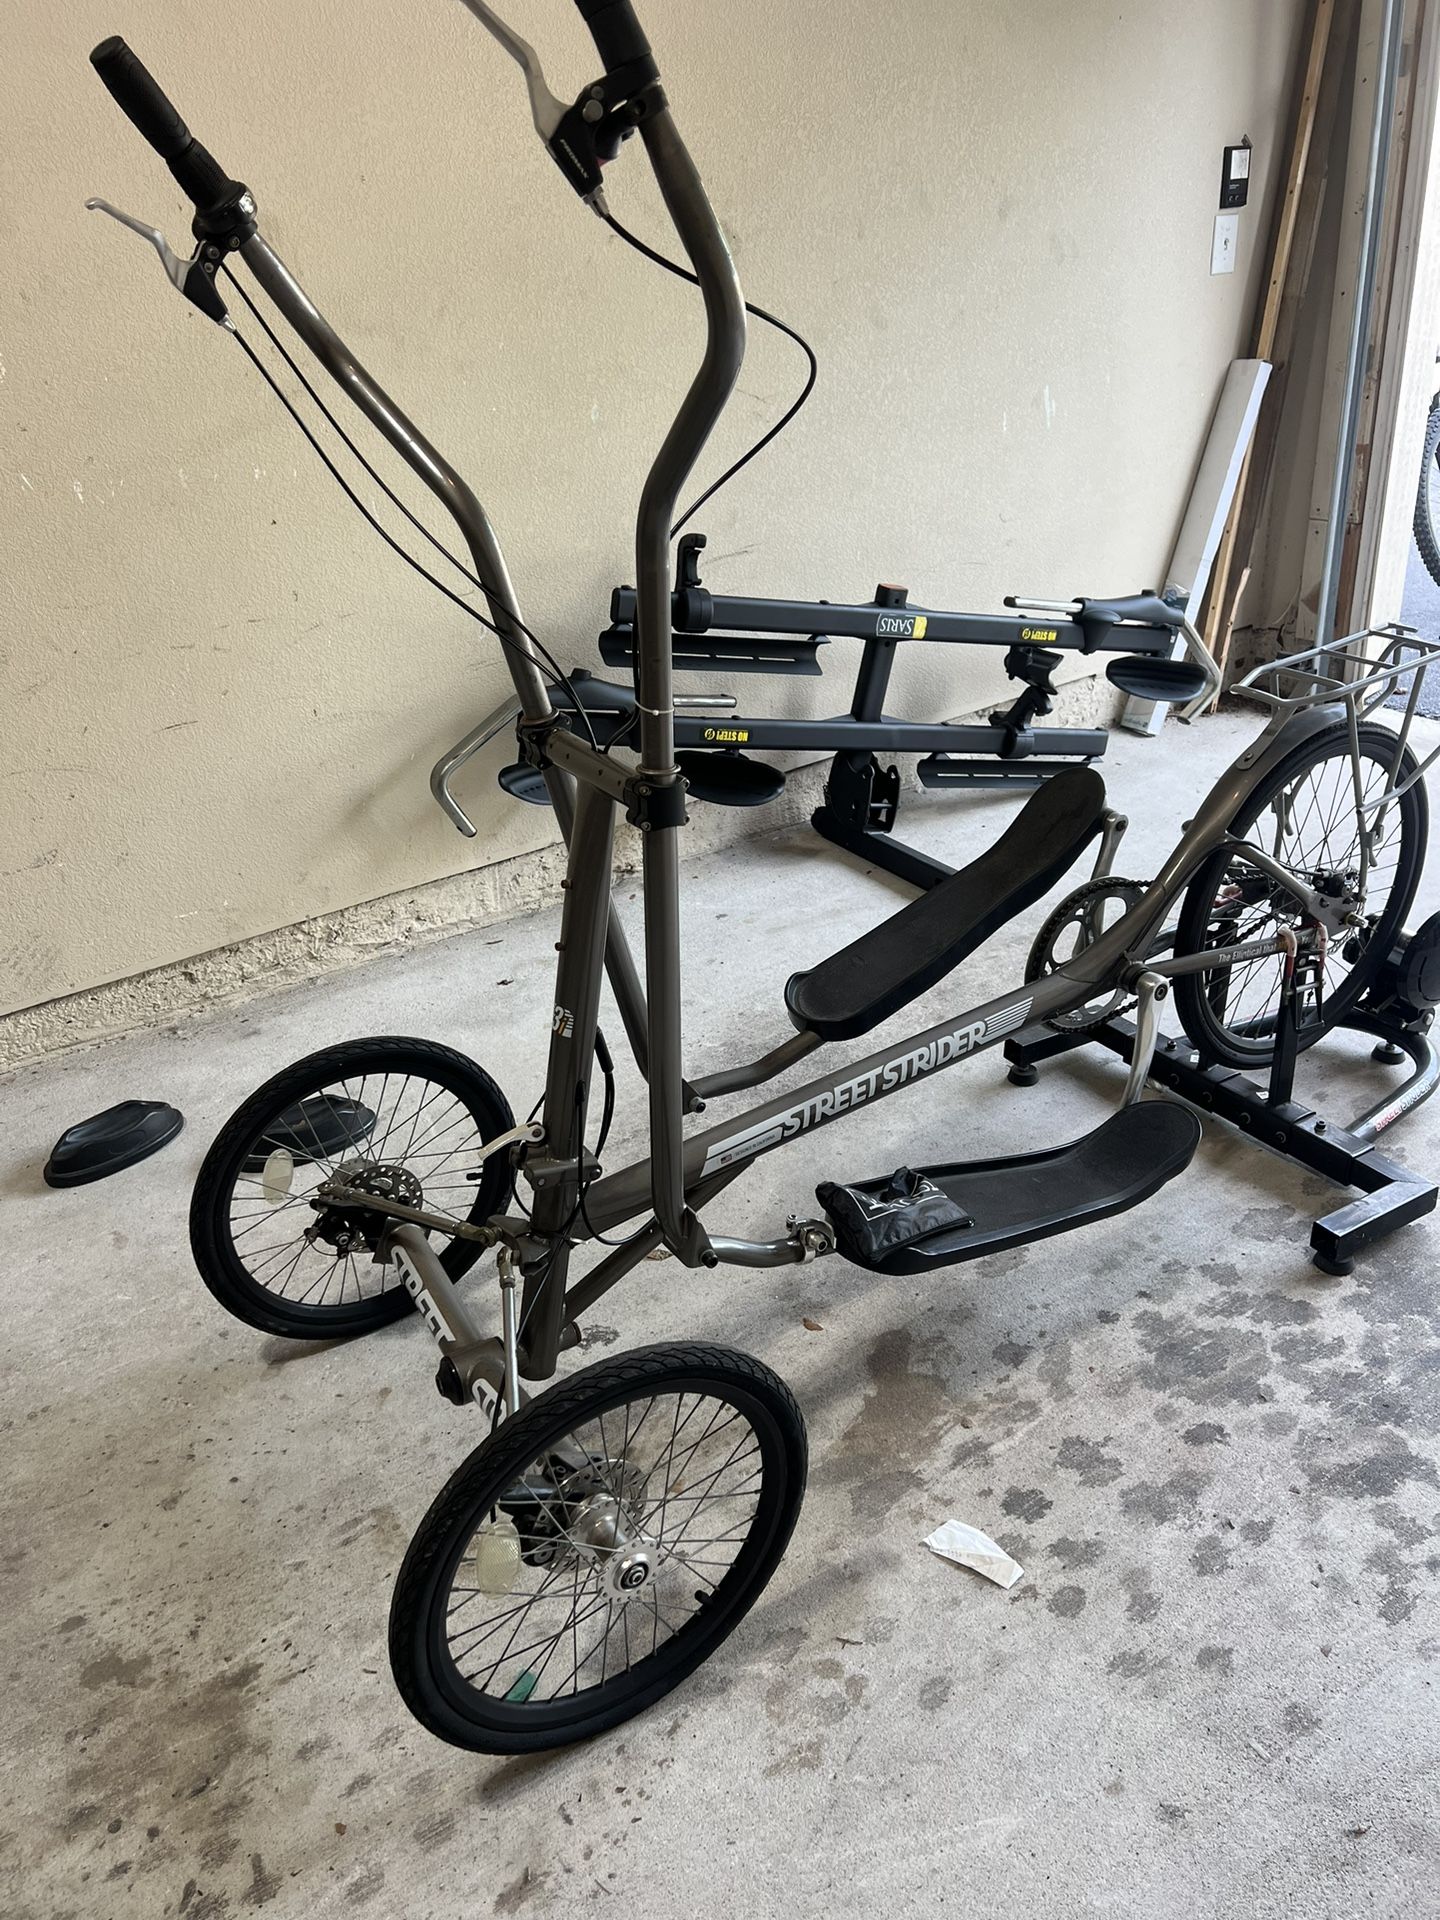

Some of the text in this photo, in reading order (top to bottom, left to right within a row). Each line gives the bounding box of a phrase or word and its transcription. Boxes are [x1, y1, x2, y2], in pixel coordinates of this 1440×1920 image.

[879, 617, 914, 635] SARIS
[1047, 631, 1057, 641] NO
[715, 730, 749, 742] NO STEP!
[783, 1020, 986, 1137] STREETSTRIDER
